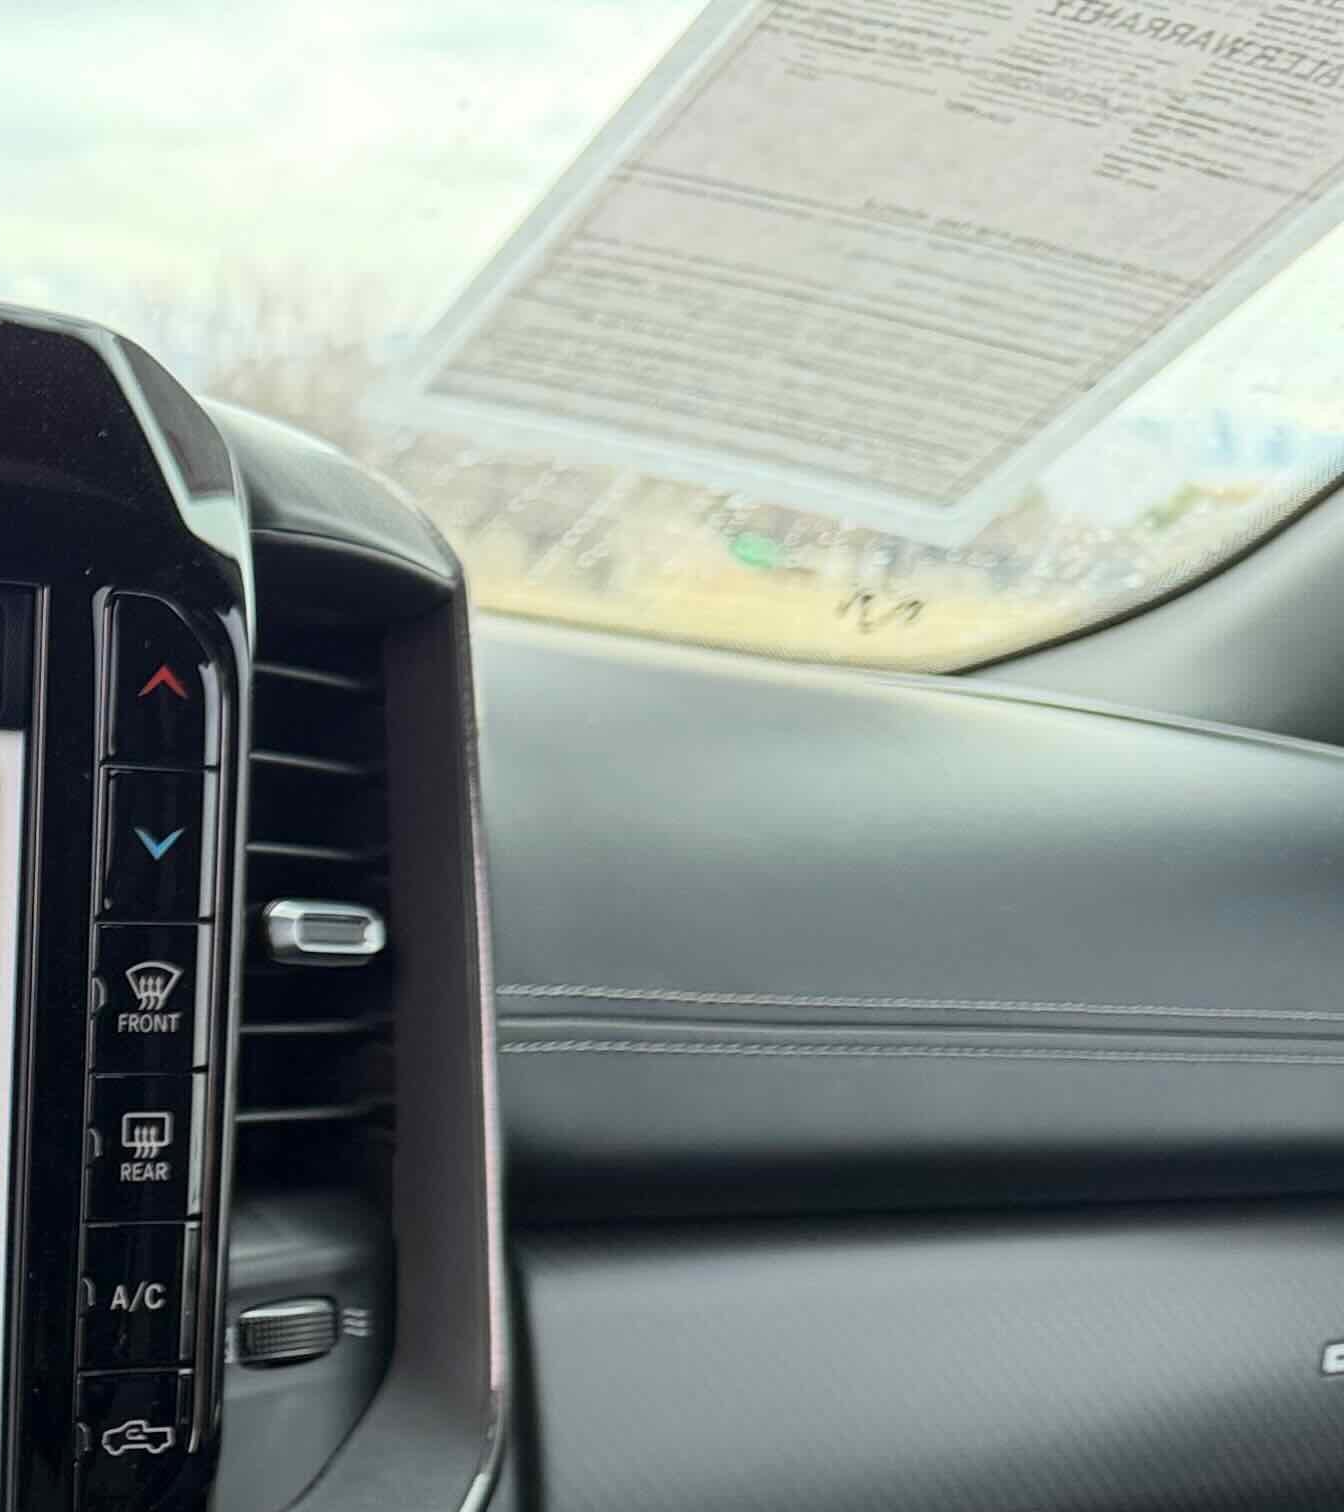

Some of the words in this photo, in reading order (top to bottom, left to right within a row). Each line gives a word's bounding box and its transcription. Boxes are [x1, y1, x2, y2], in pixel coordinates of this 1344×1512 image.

[117, 1013, 180, 1033] FRONT
[120, 1162, 169, 1182] REAR
[110, 1281, 166, 1311] A/C
